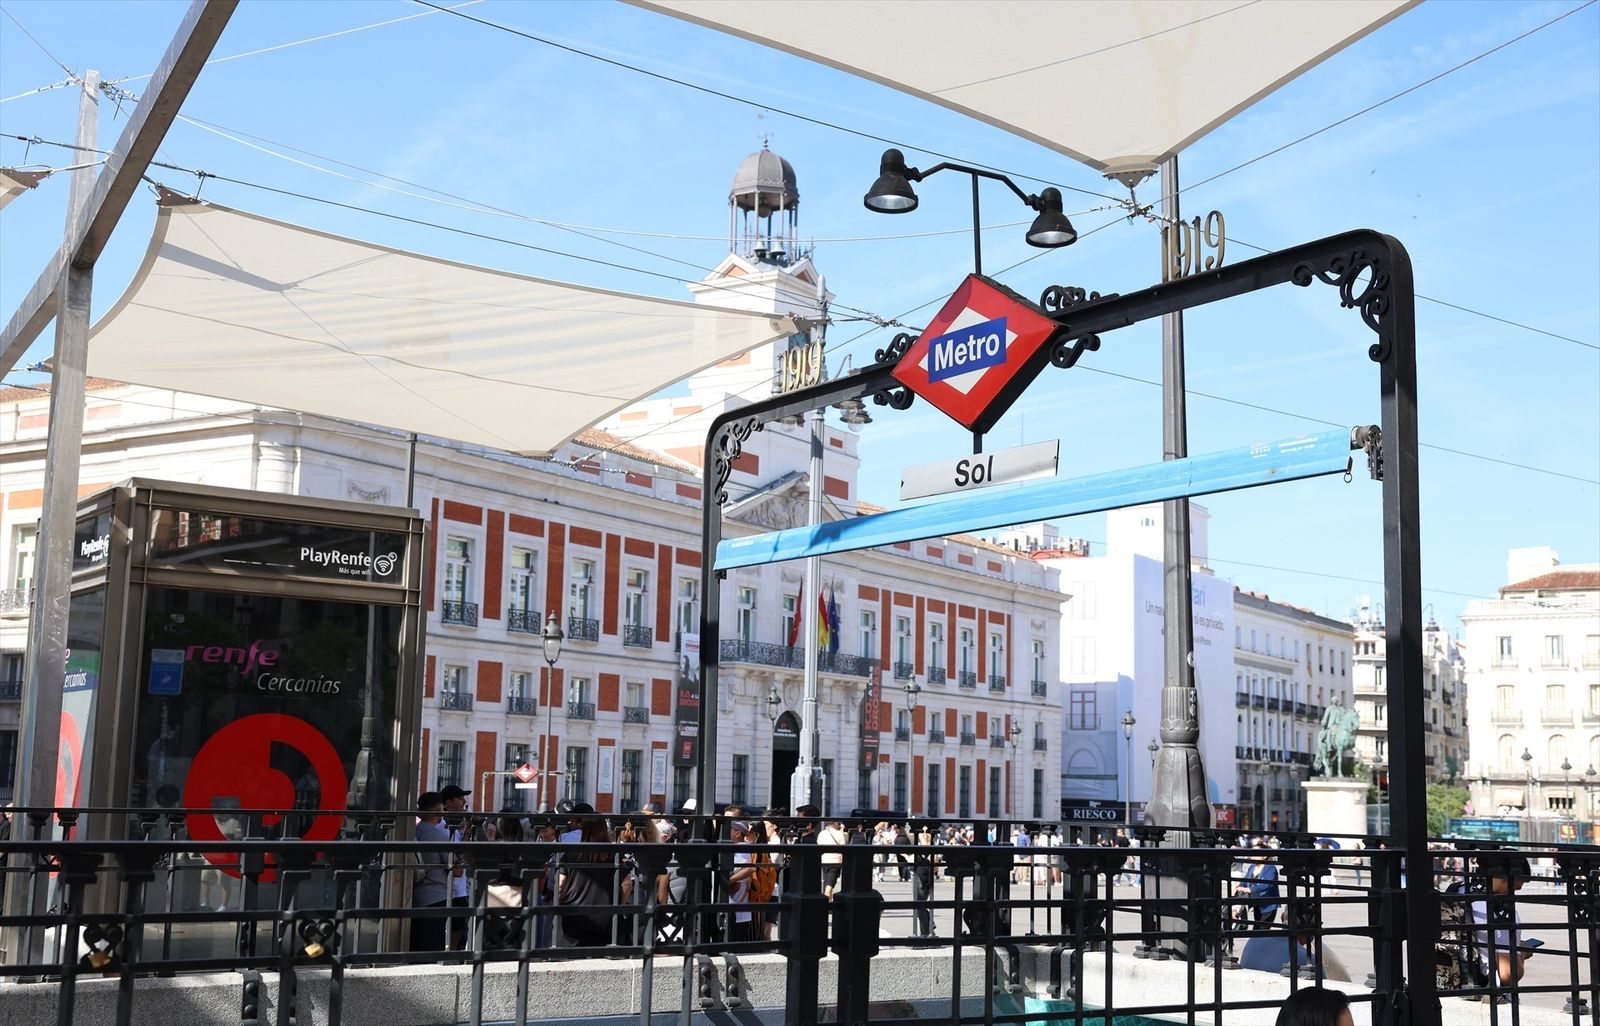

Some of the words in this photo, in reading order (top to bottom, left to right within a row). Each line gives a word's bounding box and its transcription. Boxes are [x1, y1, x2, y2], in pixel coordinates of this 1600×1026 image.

[1162, 210, 1225, 283] 1919
[782, 340, 822, 392] 1919
[934, 333, 1000, 372] Metro
[954, 455, 994, 487] Sol
[301, 547, 372, 566] PlayRenfe
[339, 566, 349, 574] Más
[185, 639, 281, 675] renfe
[257, 673, 341, 694] Cercanías
[1073, 808, 1117, 820] RIESCO
